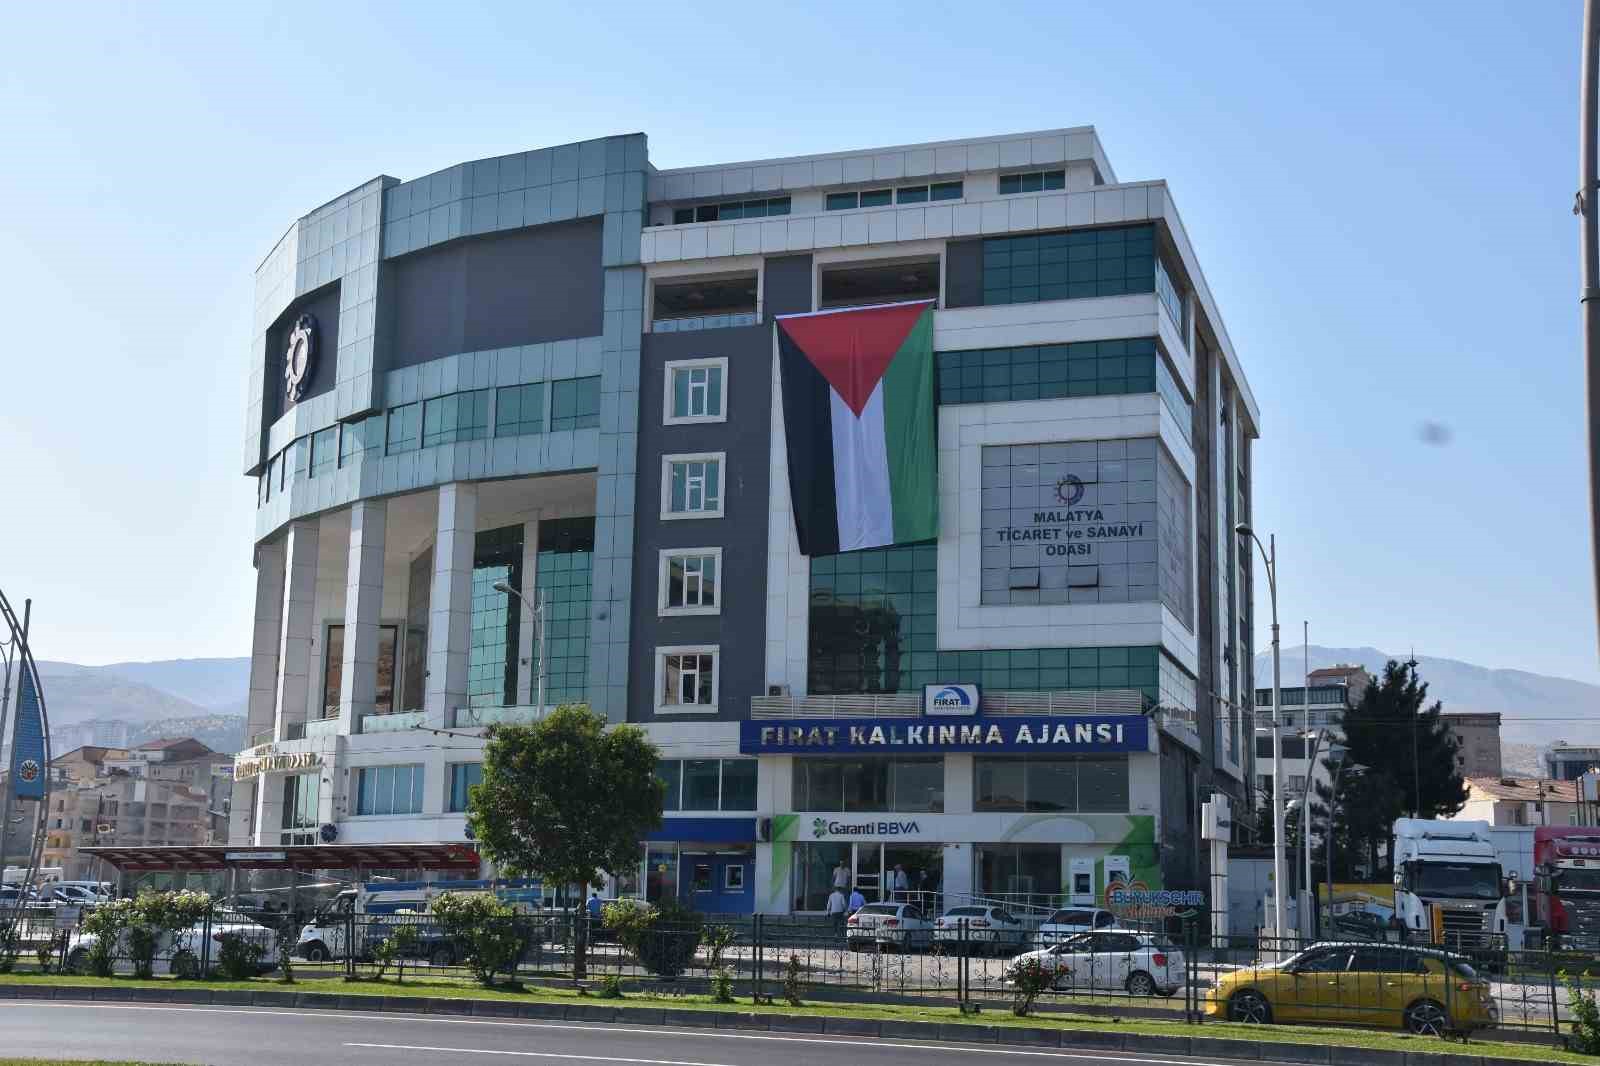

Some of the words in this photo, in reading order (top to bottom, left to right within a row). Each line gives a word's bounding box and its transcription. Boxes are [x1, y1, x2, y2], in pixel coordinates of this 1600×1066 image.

[1033, 510, 1104, 523] MALATYA
[996, 527, 1062, 542] TİCARET
[1065, 530, 1083, 539] ve
[1087, 523, 1143, 538] SANAYİ
[1046, 544, 1092, 556] ODASI
[933, 698, 961, 706] FIRAT
[760, 726, 840, 746] FIRAT
[850, 725, 1004, 745] KALKINMA
[1015, 723, 1123, 744] AJANSI
[828, 821, 875, 835] Garanti
[877, 821, 920, 834] BBVA
